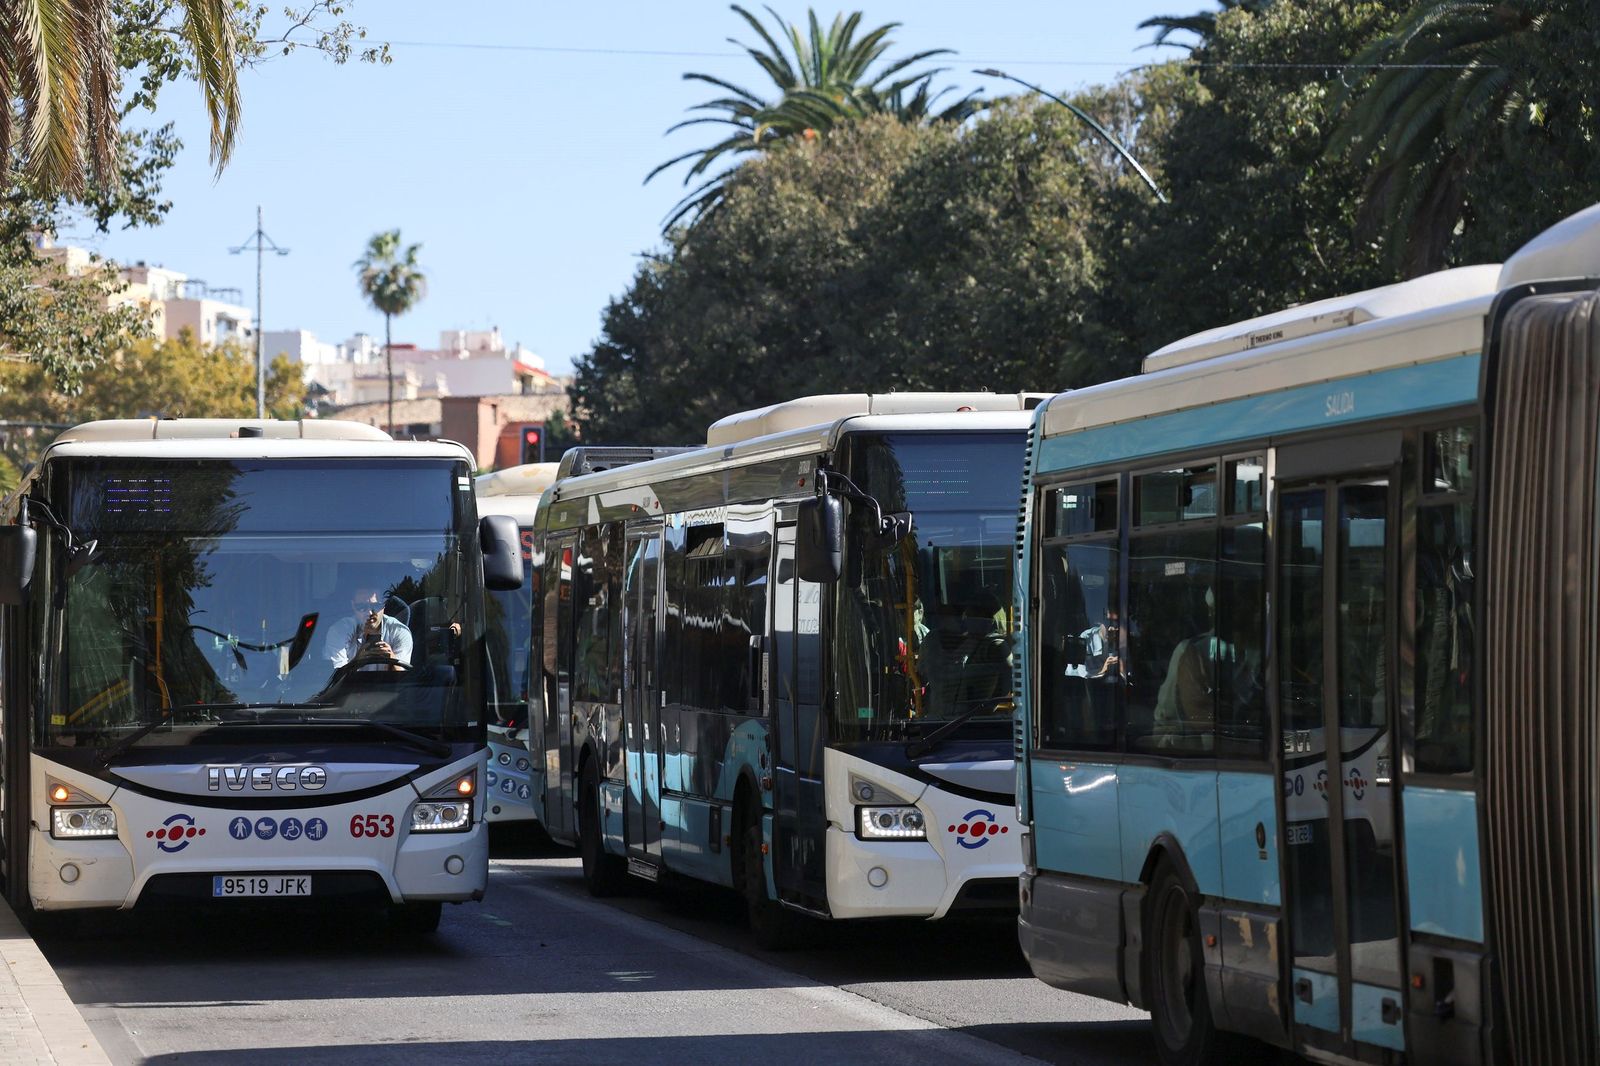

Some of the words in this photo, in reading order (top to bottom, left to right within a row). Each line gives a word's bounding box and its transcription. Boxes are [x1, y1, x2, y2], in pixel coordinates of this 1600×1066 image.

[1255, 333, 1272, 343] THERMO
[1273, 331, 1283, 339] KING
[1326, 392, 1354, 416] SALIDA
[208, 765, 327, 791] IVECO
[349, 814, 395, 838] 653
[224, 878, 269, 894] 9519
[275, 878, 306, 894] JFK
